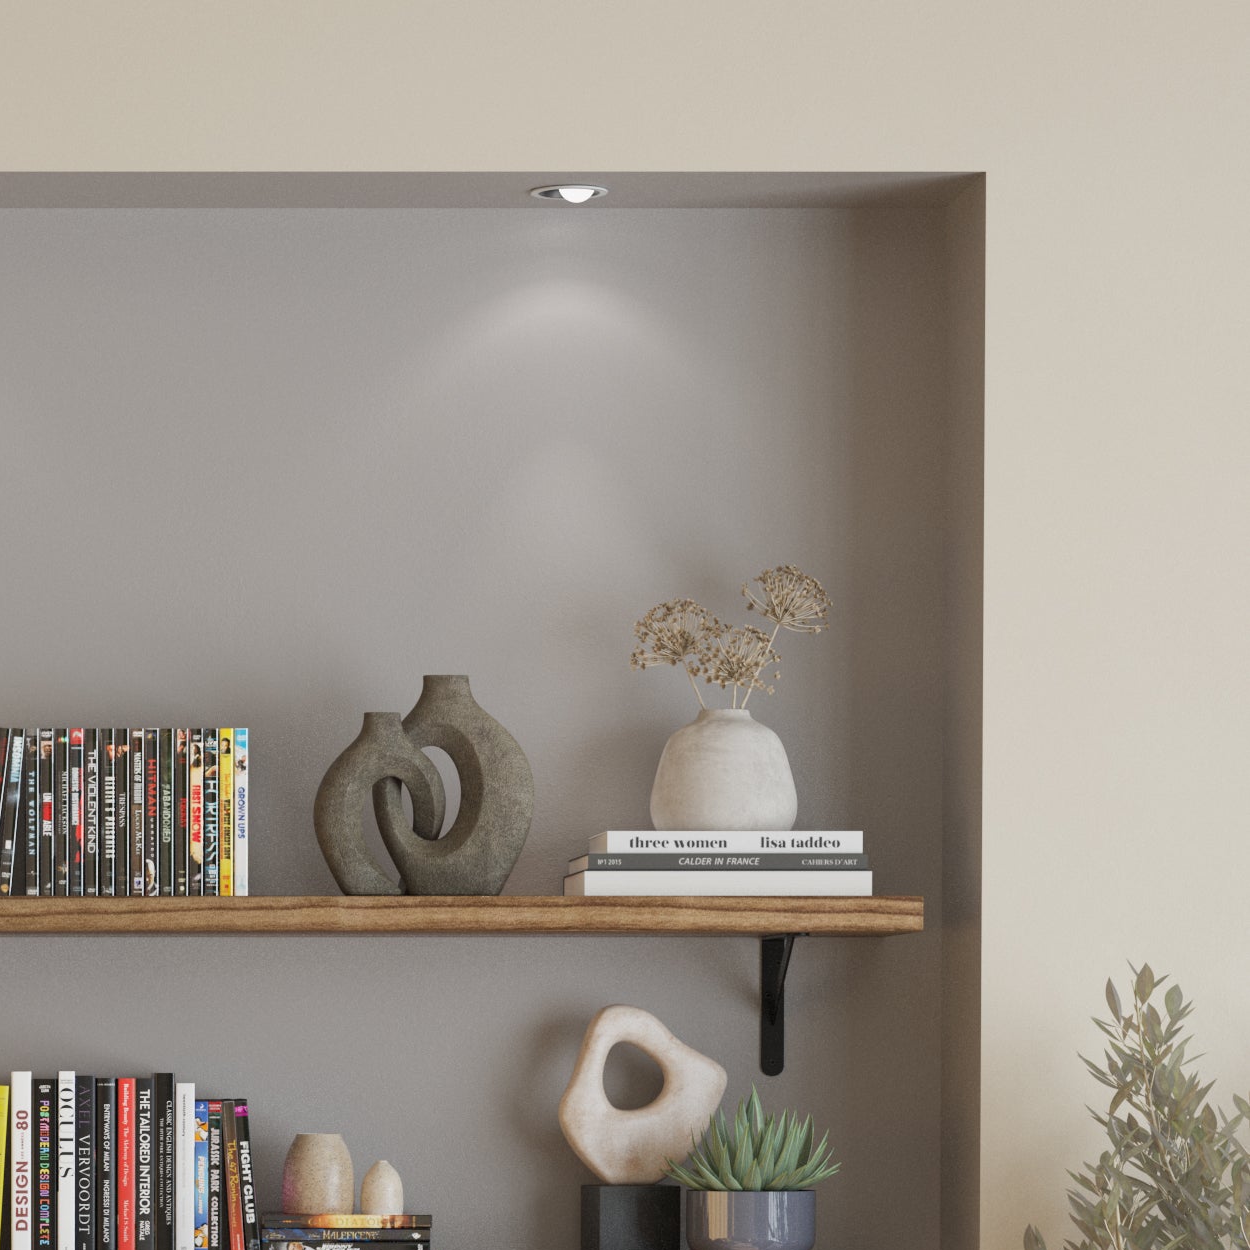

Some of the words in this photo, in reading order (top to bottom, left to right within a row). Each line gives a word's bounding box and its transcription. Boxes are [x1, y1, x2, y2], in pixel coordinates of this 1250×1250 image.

[10, 736, 22, 783] INSOMNIA
[148, 759, 156, 817] HITMAN
[192, 785, 201, 805] FIRST
[192, 807, 201, 843] SNOW
[629, 837, 669, 848] three
[674, 839, 728, 848] women
[760, 836, 786, 848] lisa
[790, 836, 840, 848] taddeo
[678, 857, 712, 866] CALDER
[714, 857, 724, 866] IN
[726, 857, 760, 866] FRANCE
[79, 1085, 90, 1128] AXEL
[140, 1089, 150, 1110] THE
[16, 1110, 28, 1130] 80
[40, 1100, 50, 1160] POSTMODERN
[59, 1088, 74, 1178] OCULUS
[140, 1112, 150, 1163] TAILORED
[103, 1141, 110, 1150] OF
[210, 1128, 220, 1165] JURASSIC
[227, 1140, 237, 1161] The
[240, 1141, 252, 1182] FIGHT
[40, 1163, 50, 1196] DESIGN
[78, 1134, 90, 1234] VERVOORDT
[210, 1169, 220, 1192] PARK
[229, 1162, 237, 1172] 47
[16, 1161, 28, 1232] DESIGN
[140, 1165, 150, 1214] INTERIOR
[230, 1174, 238, 1202] Ronin
[242, 1184, 256, 1224] CLUB
[40, 1199, 50, 1246] COMPLETE
[210, 1196, 219, 1247] COLLECTION
